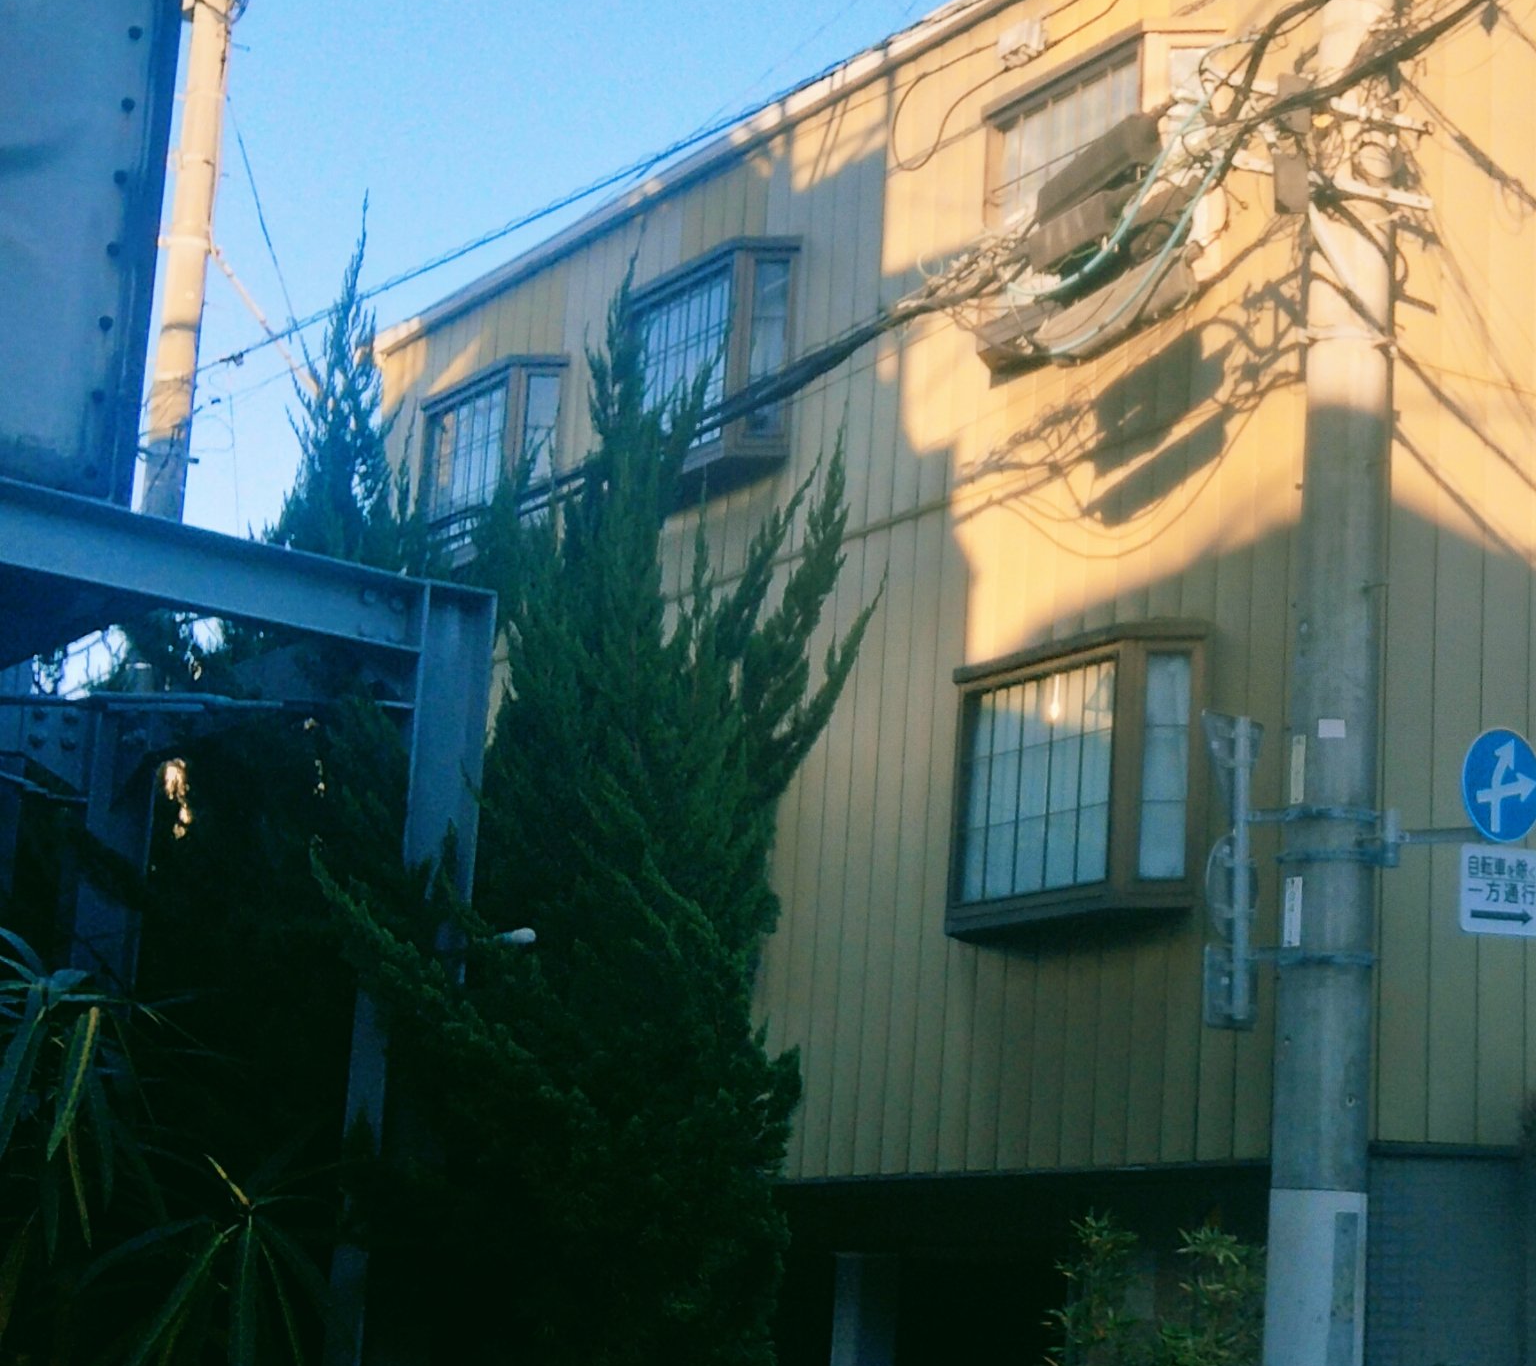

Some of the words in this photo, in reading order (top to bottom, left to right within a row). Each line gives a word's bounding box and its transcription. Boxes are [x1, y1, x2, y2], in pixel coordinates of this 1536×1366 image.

[1467, 855, 1536, 880] 自転車を除く
[1467, 882, 1536, 906] 一方通行
